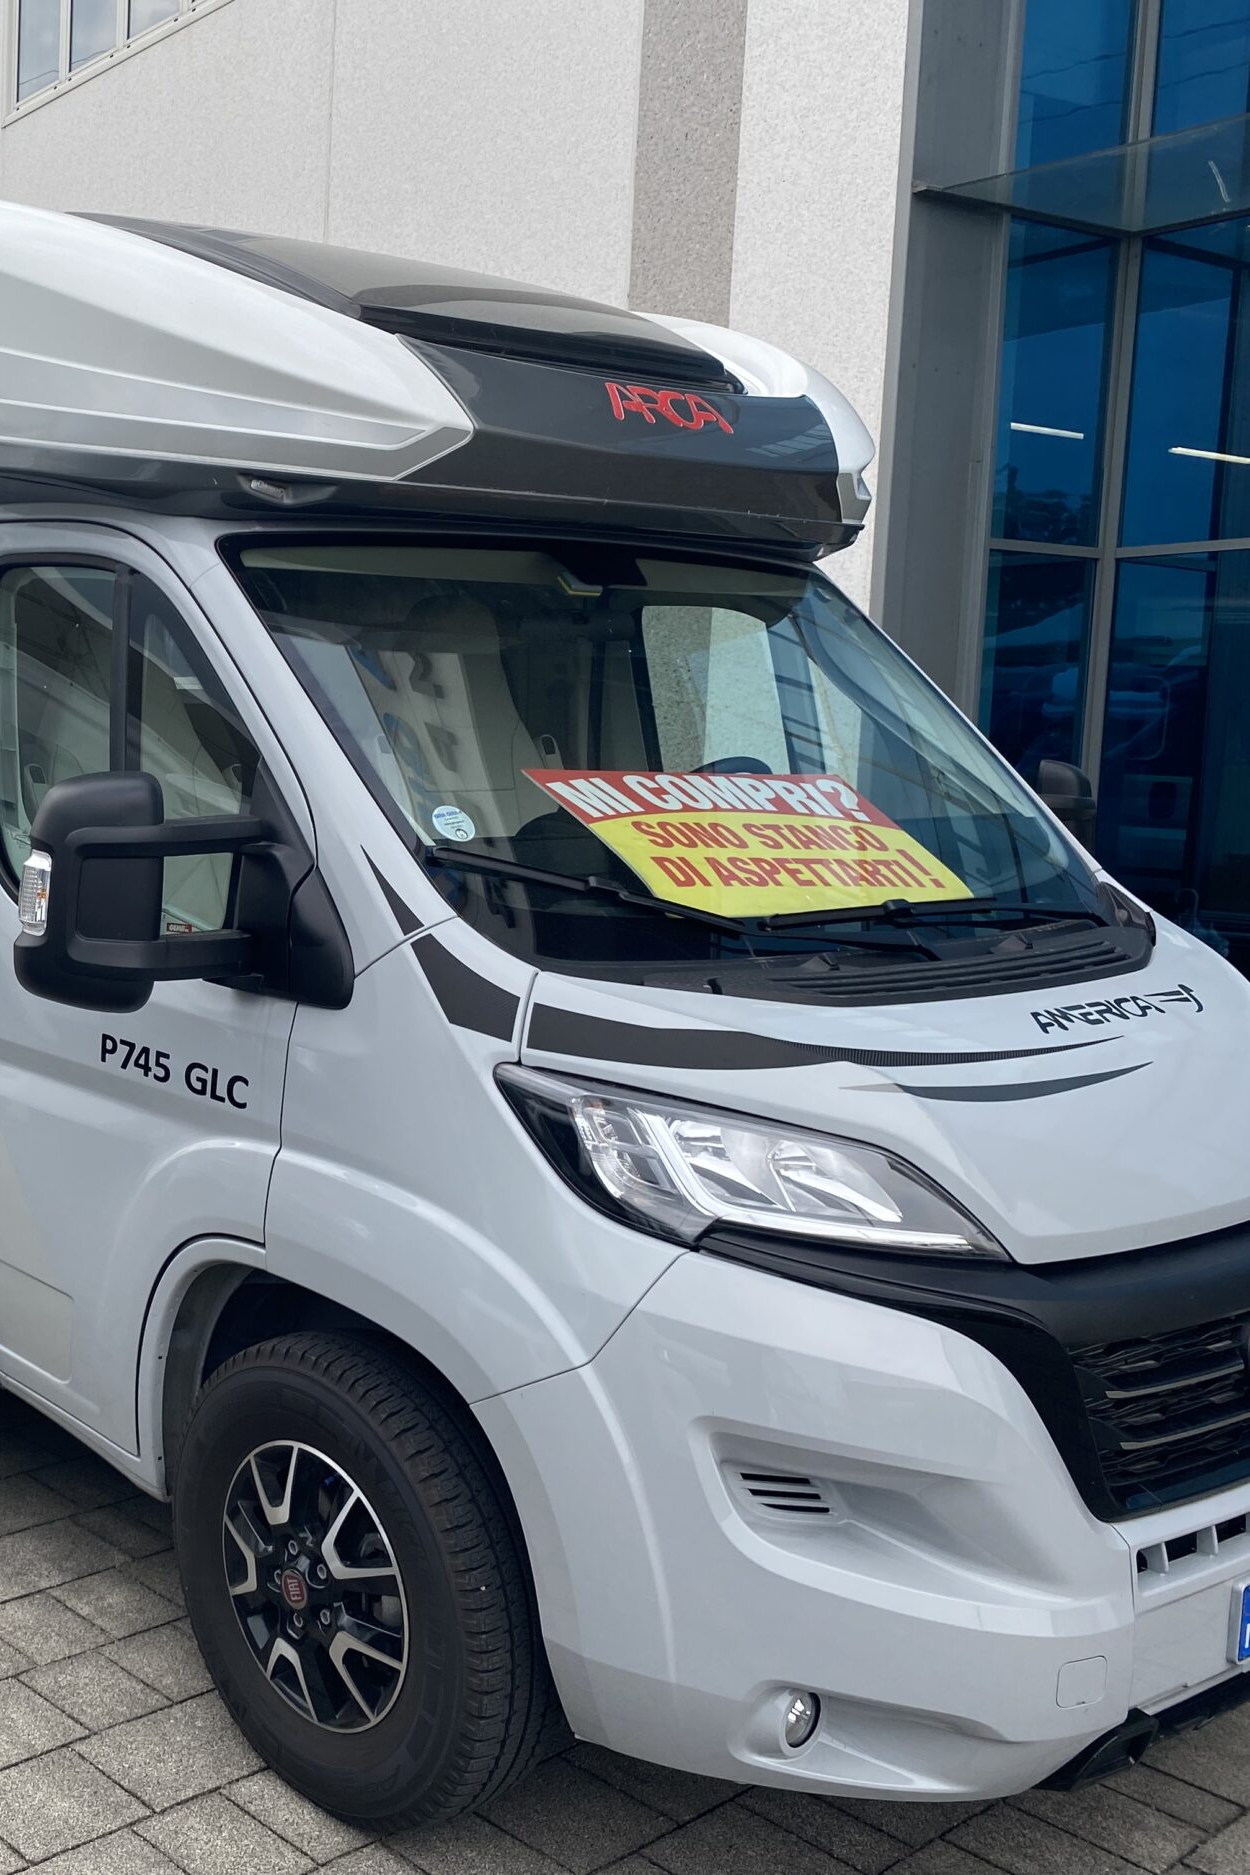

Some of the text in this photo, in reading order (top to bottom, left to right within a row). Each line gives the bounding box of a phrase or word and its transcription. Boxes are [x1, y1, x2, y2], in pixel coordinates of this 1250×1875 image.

[605, 382, 735, 435] ARCA
[545, 774, 871, 822] MI COMPRI?
[631, 821, 889, 851] SONO STANCO
[649, 849, 946, 888] DI ASPETTARTI!
[1030, 995, 1166, 1034] AMERICA
[100, 1033, 249, 1110] P745 GLC
[287, 1577, 302, 1601] FIAT
